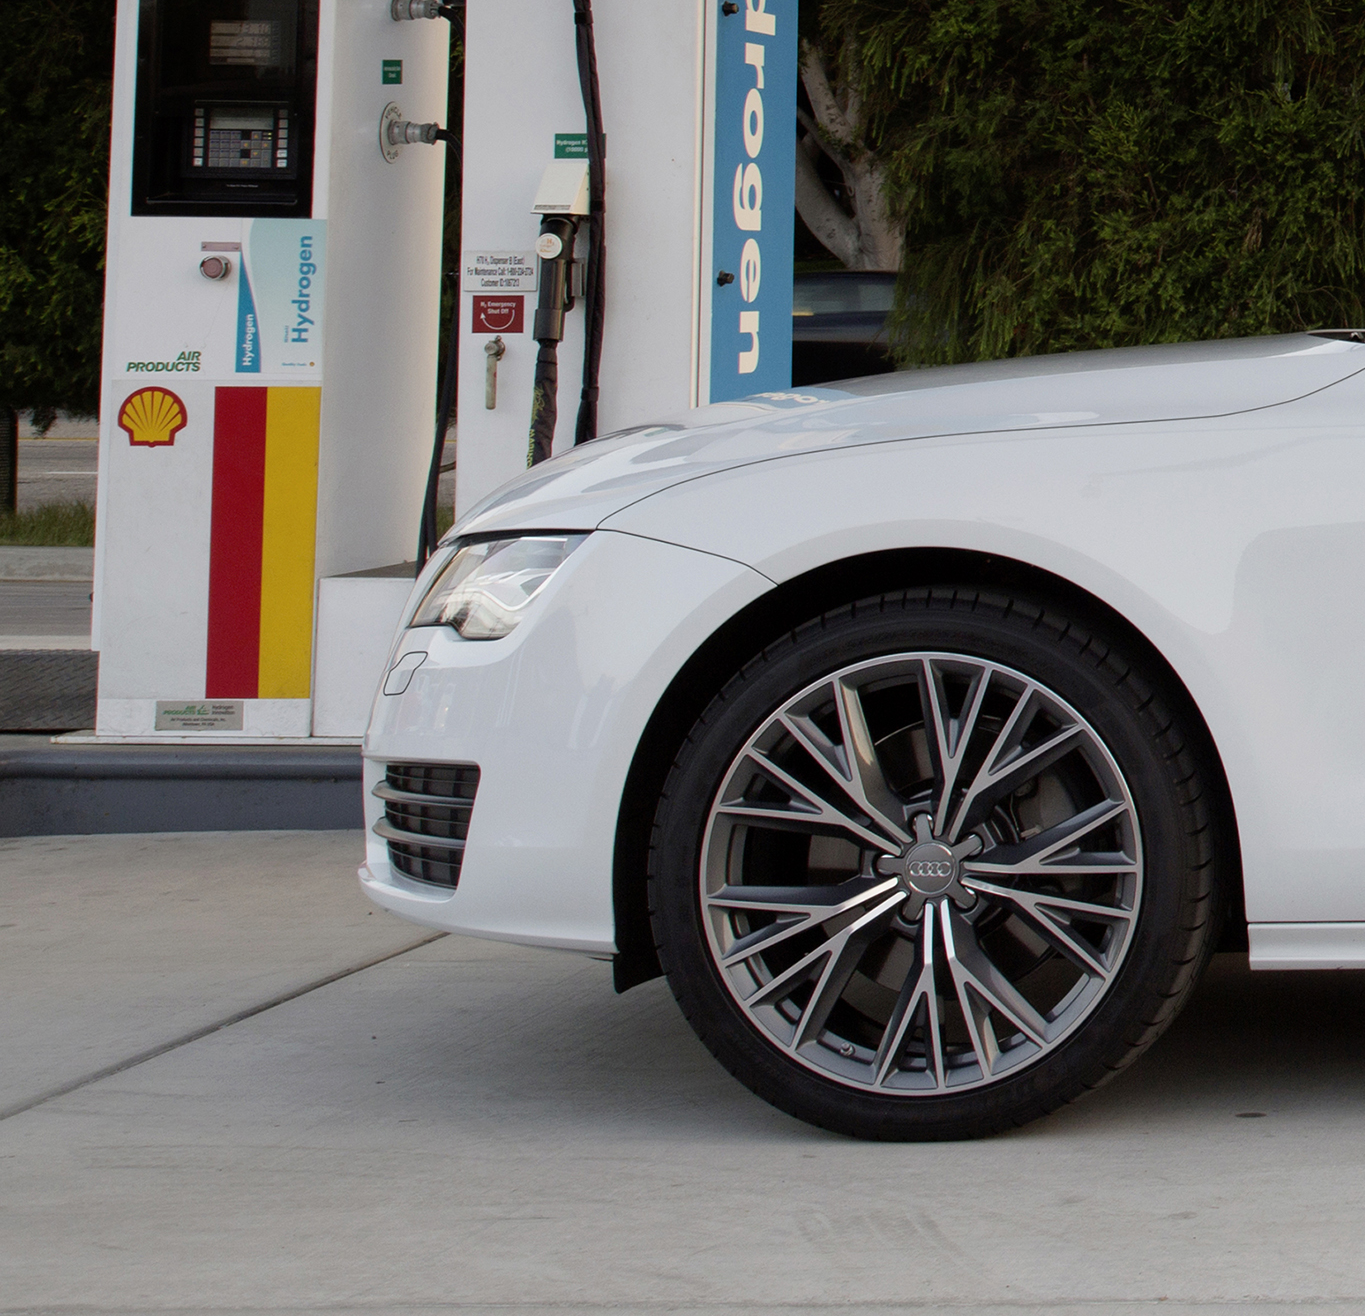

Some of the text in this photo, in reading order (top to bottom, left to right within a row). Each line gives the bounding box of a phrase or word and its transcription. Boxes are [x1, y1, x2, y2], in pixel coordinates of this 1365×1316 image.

[291, 236, 317, 343] Hydrogen
[242, 314, 256, 366] Hydrogen
[126, 362, 201, 372] PRODUCTS
[177, 351, 201, 361] AIR
